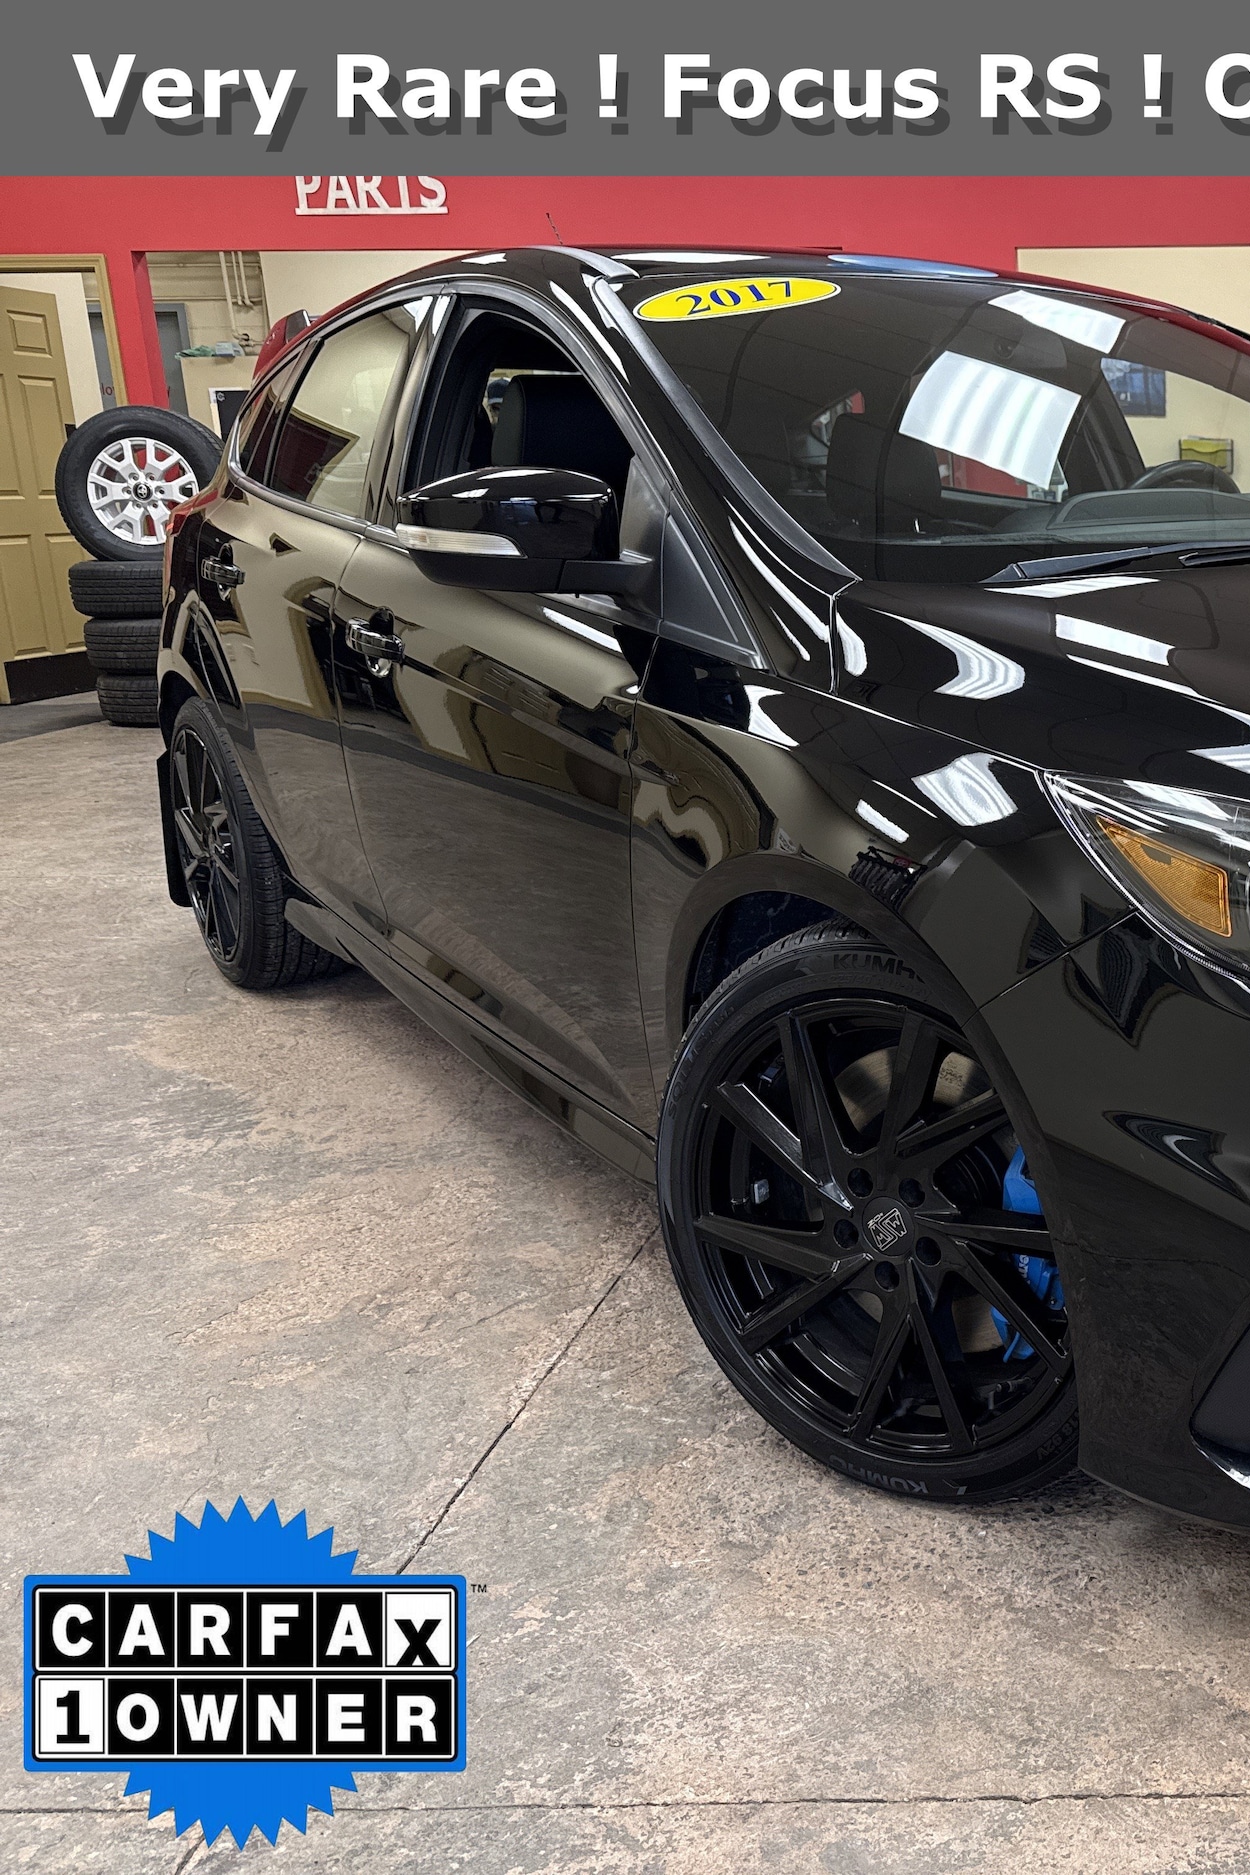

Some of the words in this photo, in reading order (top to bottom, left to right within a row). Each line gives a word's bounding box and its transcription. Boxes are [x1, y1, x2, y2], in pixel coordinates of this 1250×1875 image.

[295, 175, 448, 210] PARTS
[676, 280, 792, 316] 2017
[833, 953, 926, 984] KUMH
